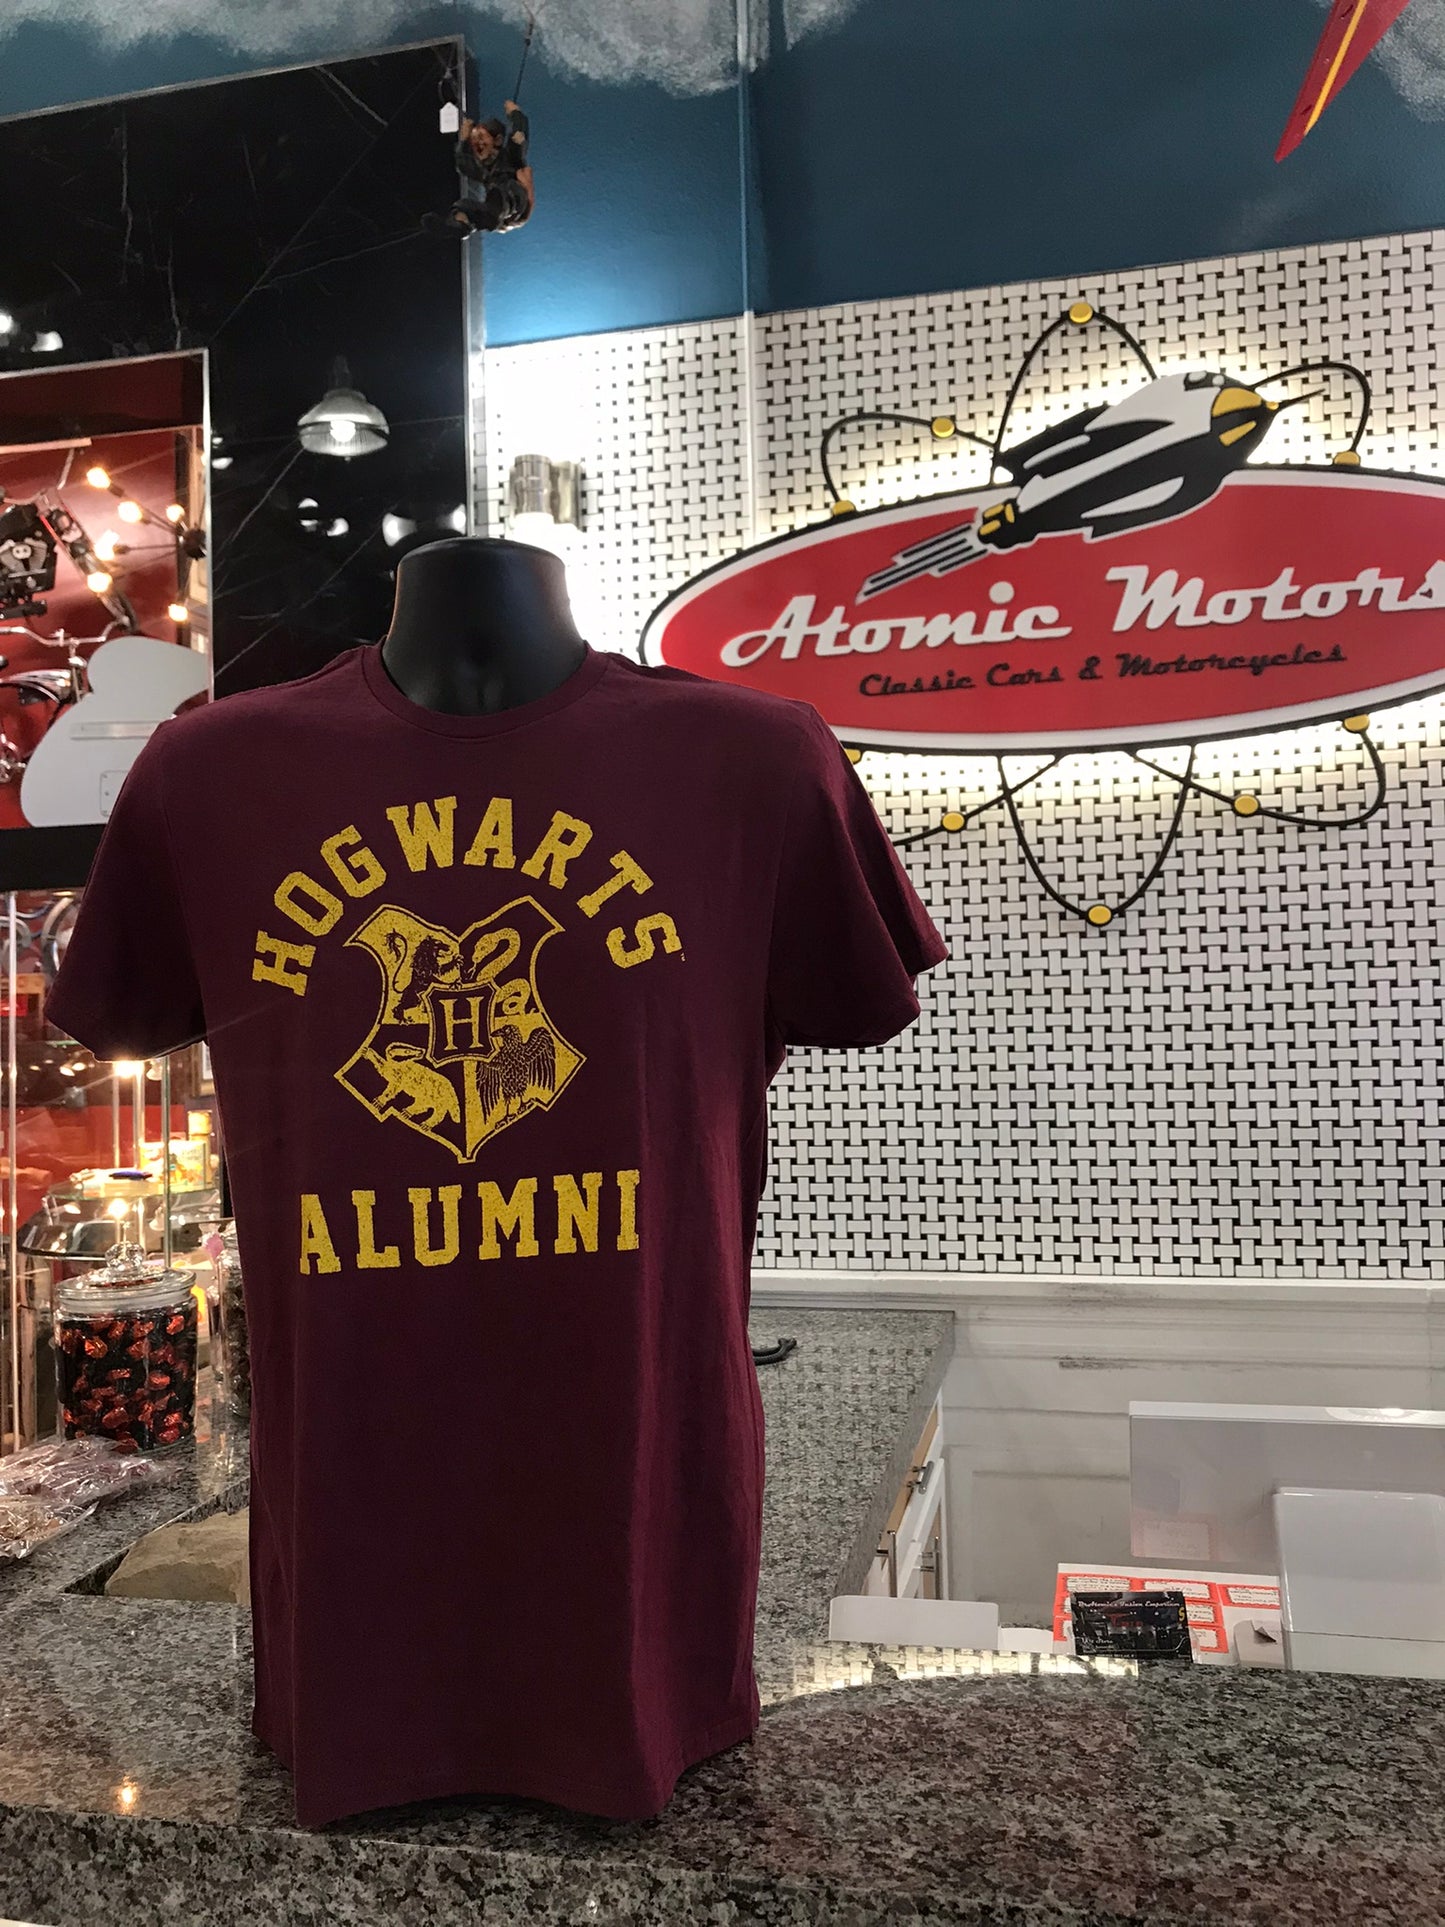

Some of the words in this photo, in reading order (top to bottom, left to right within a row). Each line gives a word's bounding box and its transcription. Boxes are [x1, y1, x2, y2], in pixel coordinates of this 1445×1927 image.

[720, 581, 1073, 667] Atomic
[1105, 559, 1445, 632] Motors
[859, 670, 976, 696] Classic
[986, 663, 1064, 686] Cars
[1078, 656, 1103, 680] &
[1116, 644, 1347, 676] Motorcycles
[252, 796, 683, 997] HOGWARTS
[439, 996, 484, 1051] H
[300, 1169, 640, 1275] ALUMNI
